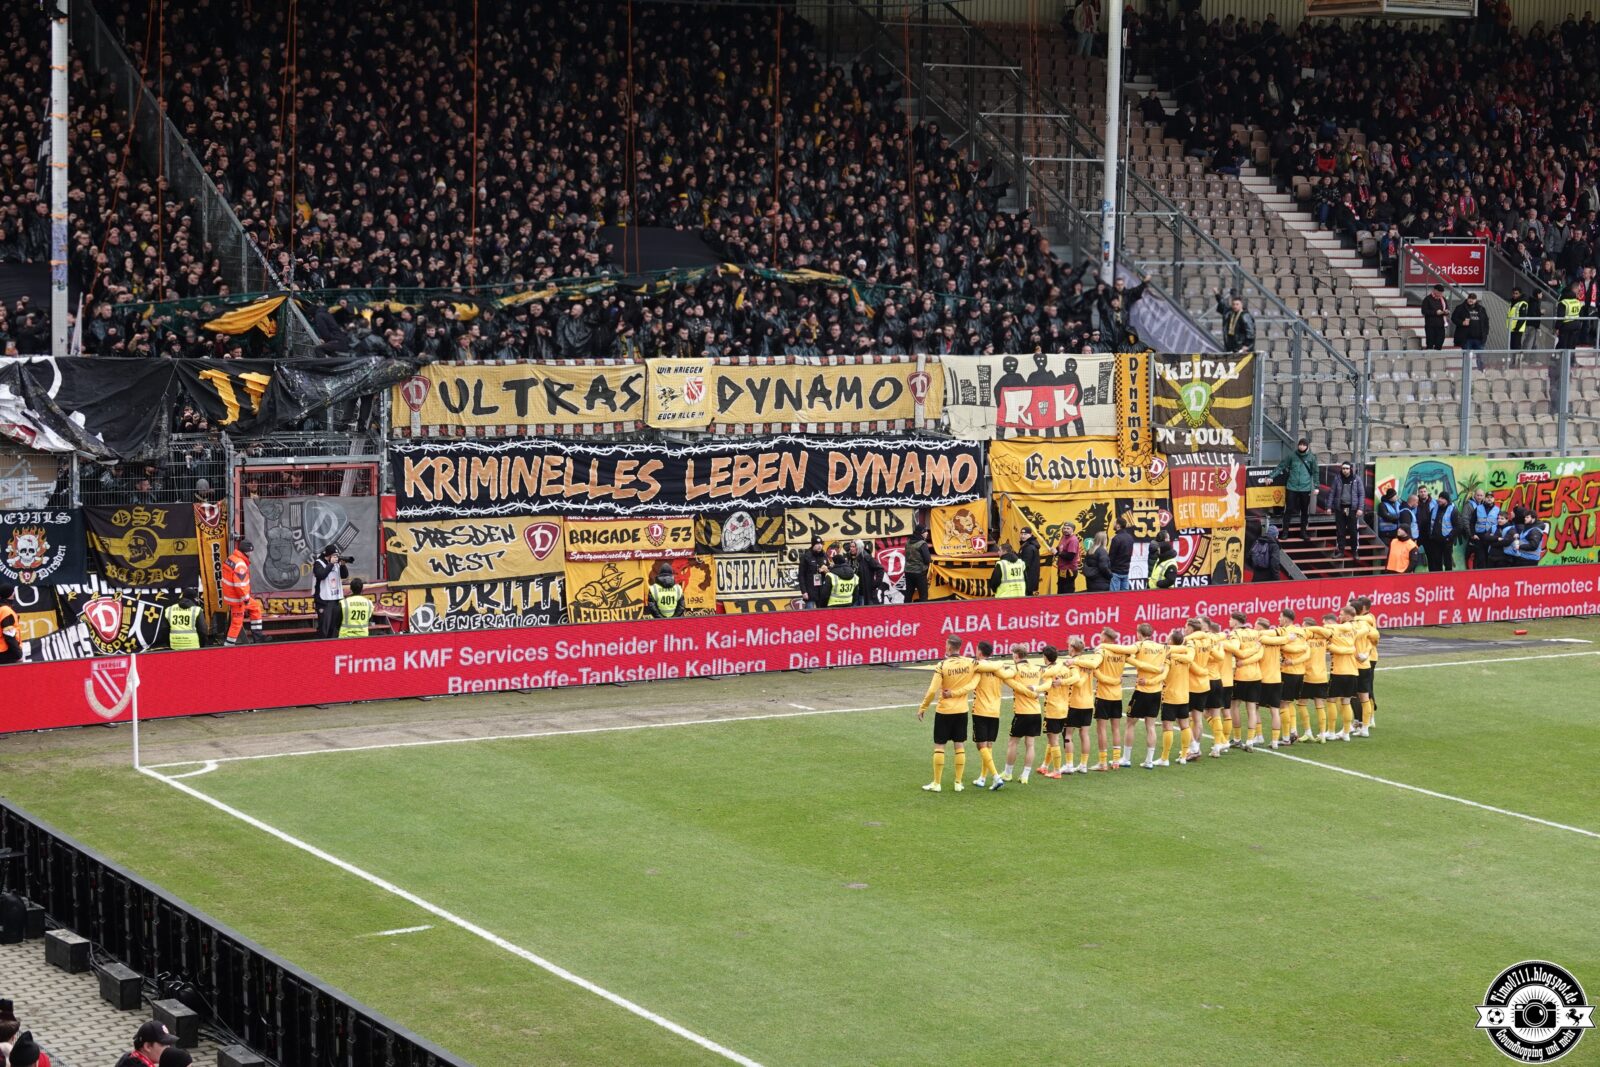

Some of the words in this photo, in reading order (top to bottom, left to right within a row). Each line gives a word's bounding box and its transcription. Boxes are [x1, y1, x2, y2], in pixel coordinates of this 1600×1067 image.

[657, 366, 671, 374] WIR
[439, 373, 643, 418] ULTRAS
[717, 373, 902, 414] DYNAMO
[678, 411, 696, 419] ALLE
[1181, 408, 1210, 429] DRESDEN
[1181, 427, 1235, 446] TOUR
[403, 454, 664, 504] KRIMINELLES
[684, 450, 809, 501] LEBEN
[828, 450, 978, 497] DYNAMO
[1183, 472, 1215, 492] HASE
[112, 506, 168, 529] OSL
[1179, 503, 1197, 520] SEIT
[1202, 502, 1220, 518] 1984
[1132, 512, 1160, 538] 53
[409, 522, 516, 552] DRESDEN
[569, 528, 641, 545] BRIGADE
[670, 527, 692, 542] 53
[665, 548, 692, 557] Dresden
[37, 545, 66, 580] Dresden
[428, 550, 507, 577] WEST
[105, 563, 180, 586] BANDE
[1175, 575, 1208, 588] FANS
[840, 583, 853, 593] 337
[380, 592, 407, 607] 53
[660, 595, 675, 605] 401
[172, 615, 190, 626] 339
[351, 610, 366, 621] 276
[568, 604, 644, 620] LEUBNITZ
[88, 611, 130, 654] DRESDEN
[334, 654, 396, 675] Firma
[403, 648, 453, 670] KMF
[459, 643, 549, 666] Services
[554, 636, 657, 660] Schneider
[664, 634, 699, 651] Ihn.
[706, 624, 820, 649] Kai-Michael
[826, 620, 920, 642] Schneider
[941, 614, 992, 634] ALBA
[998, 610, 1060, 631] Lausitz
[1066, 606, 1120, 626] GmbH
[1134, 602, 1189, 621] Allianz
[1195, 594, 1342, 617] Generalvertretung
[1342, 590, 1410, 609] Andreas
[1415, 585, 1455, 606] Splitt
[1467, 583, 1510, 602] Alpha
[1514, 579, 1593, 597] Thermotec
[432, 614, 550, 632] GENERATION
[448, 661, 679, 694] Brennstoffe-Tankstelle
[685, 657, 765, 677] Kellberg
[789, 651, 819, 669] Die
[825, 648, 863, 667] Lilie
[869, 645, 939, 664] Blumen
[1377, 611, 1424, 629] GmbH
[1439, 609, 1447, 625] F
[1452, 609, 1462, 624] &
[1467, 607, 1483, 622] W
[947, 666, 970, 677] DYNAMO
